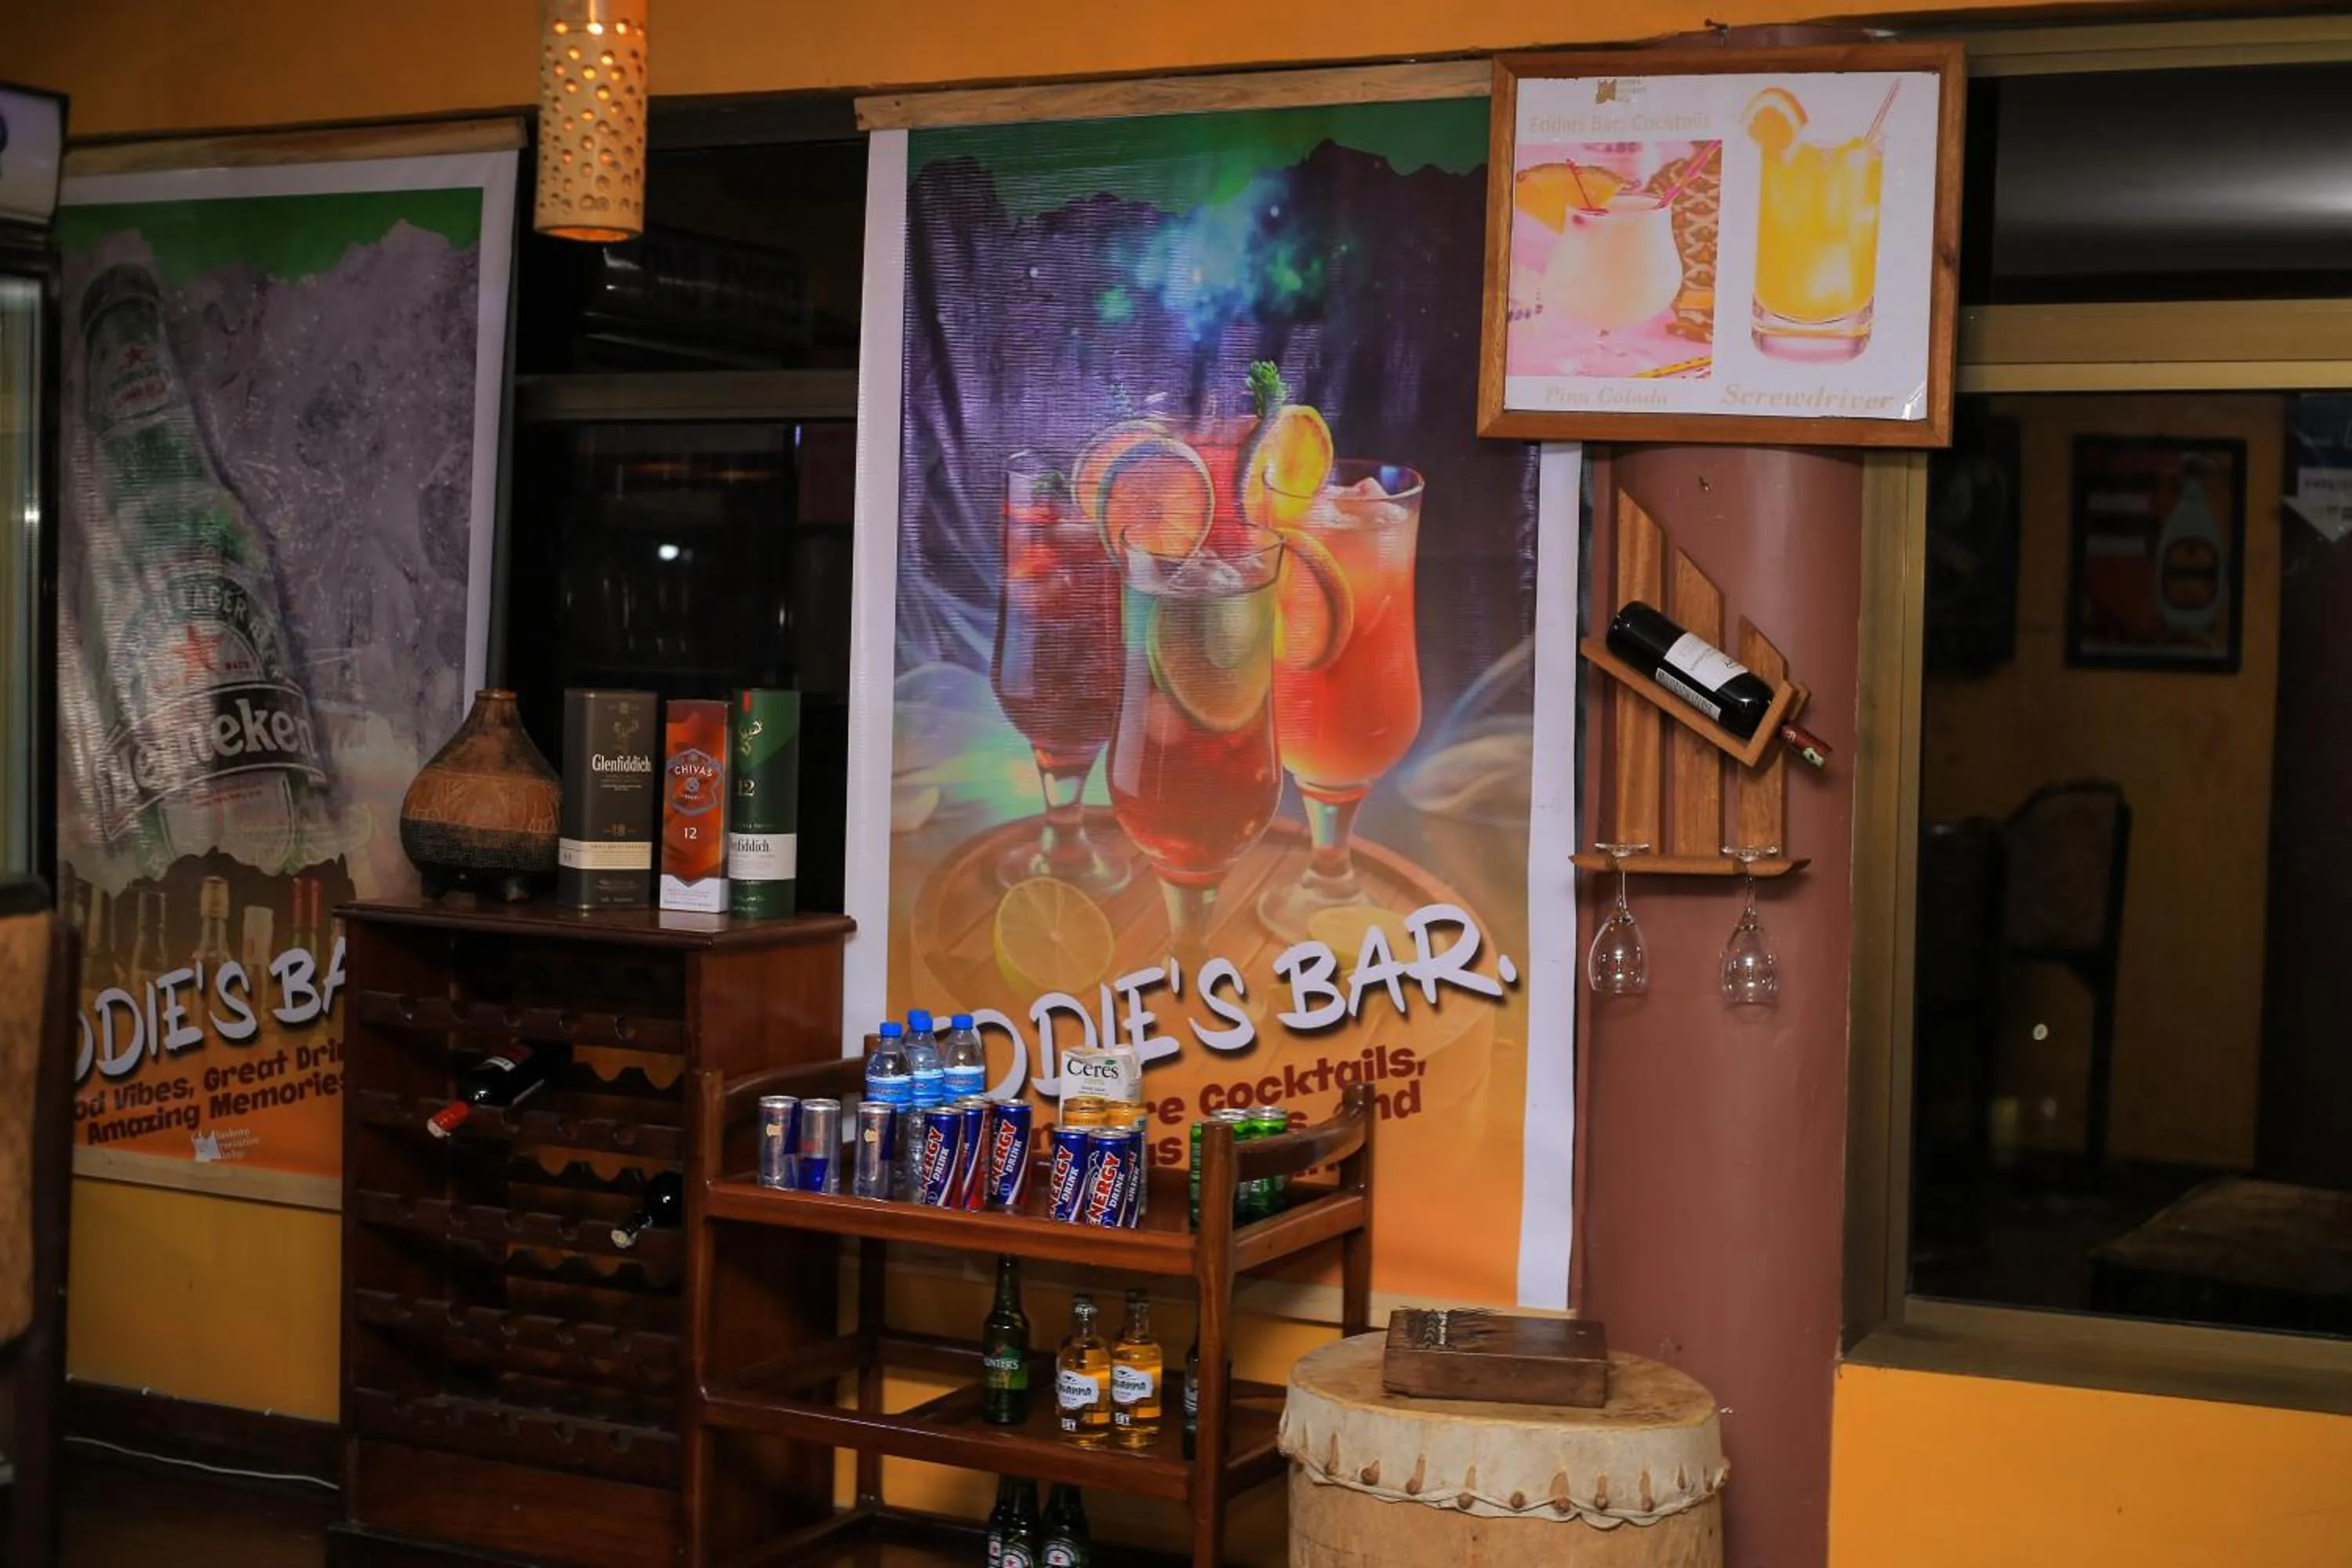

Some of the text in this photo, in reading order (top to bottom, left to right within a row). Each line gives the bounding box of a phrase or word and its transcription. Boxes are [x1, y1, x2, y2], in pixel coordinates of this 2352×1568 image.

[1721, 383, 1895, 410] Screwdriver
[592, 753, 652, 772] Glenfiddich
[674, 764, 713, 777] CHIVAS
[738, 779, 756, 797] 12
[684, 827, 697, 840] 12
[74, 935, 346, 1083] DIE'S BA
[933, 903, 1517, 1101] DDIE'S BAR.
[114, 1075, 194, 1113] Vibes,
[204, 1048, 288, 1093] Great
[1067, 1058, 1119, 1080] Ceres
[1200, 1045, 1426, 1117] cocktails,
[87, 1071, 344, 1145] Amazing Memorie
[932, 1146, 949, 1181] DRINK
[1005, 1139, 1022, 1173] DRINK
[1061, 1166, 1080, 1202] DRINK
[1109, 1171, 1125, 1209] DRINK
